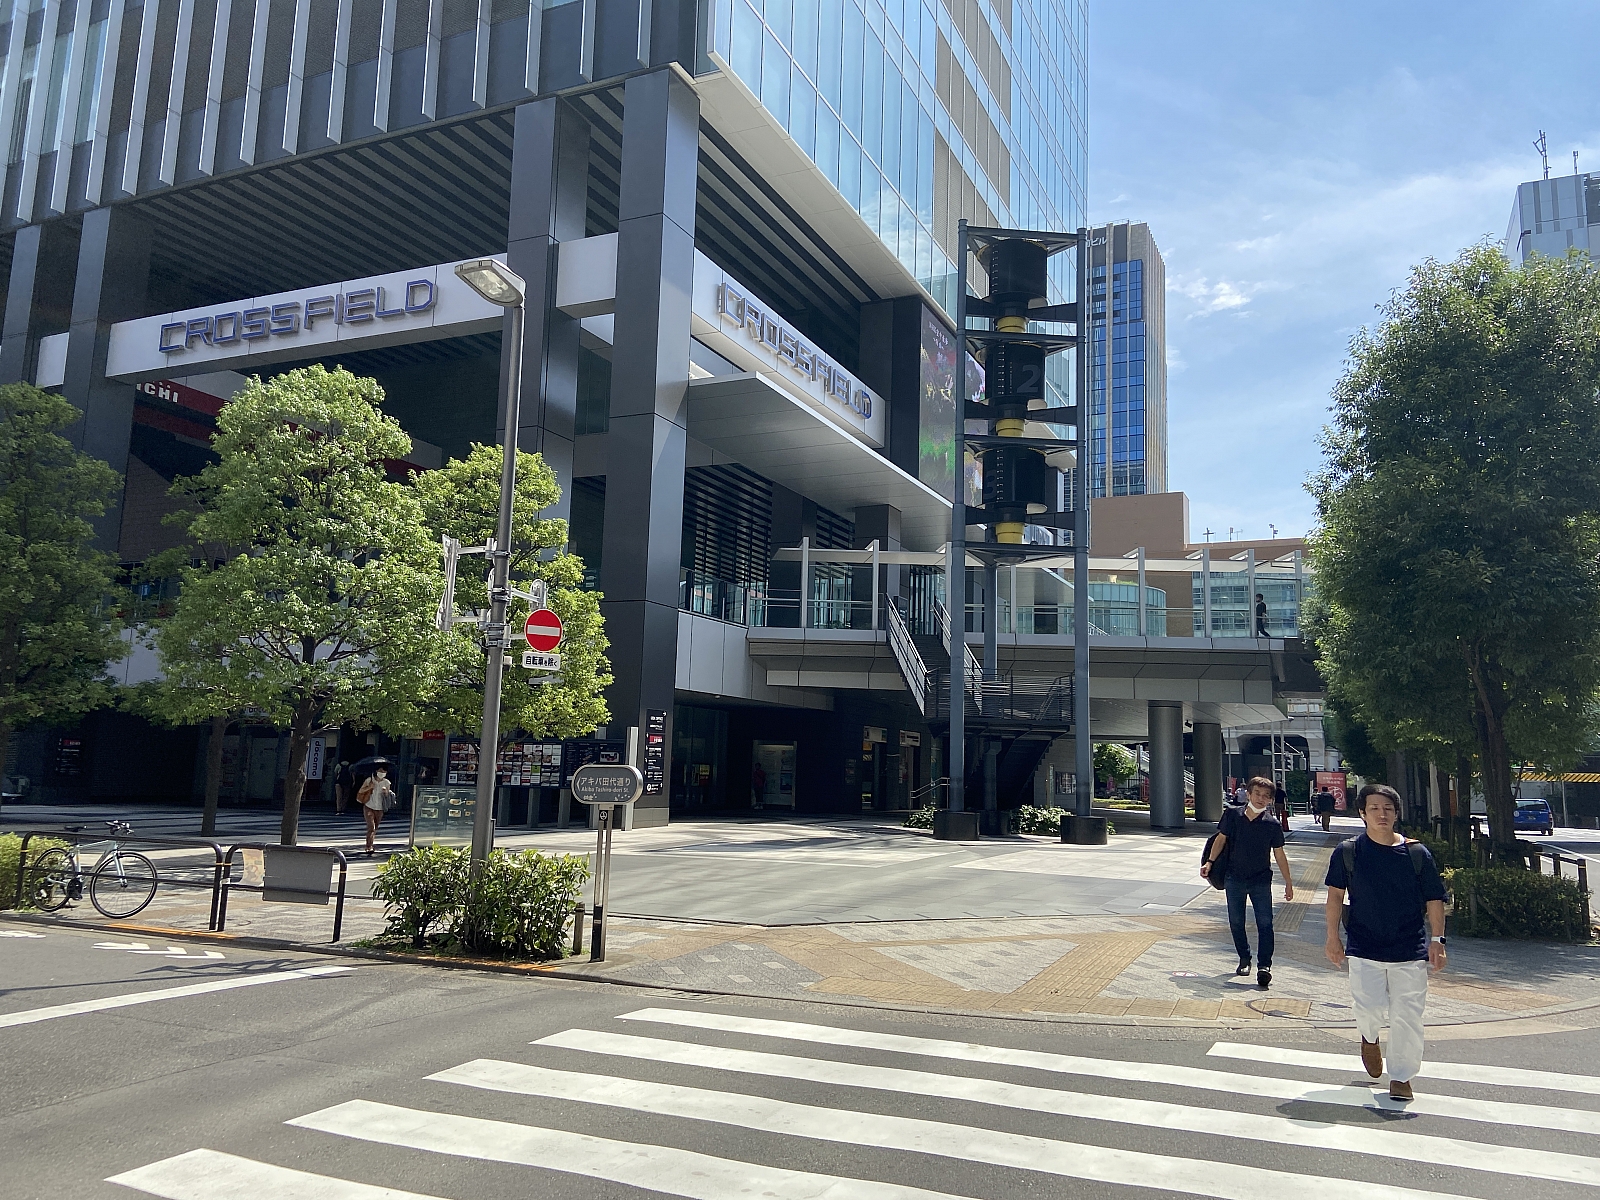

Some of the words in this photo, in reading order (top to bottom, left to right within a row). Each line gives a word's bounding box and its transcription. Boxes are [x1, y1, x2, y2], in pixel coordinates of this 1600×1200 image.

[158, 279, 437, 353] CROSSFIELD
[718, 282, 872, 420] CROSSFIELD
[1017, 364, 1041, 393] 2
[525, 655, 558, 668] 自転車を除く
[312, 740, 322, 777] docomo
[580, 777, 631, 787] アキバ田代通り
